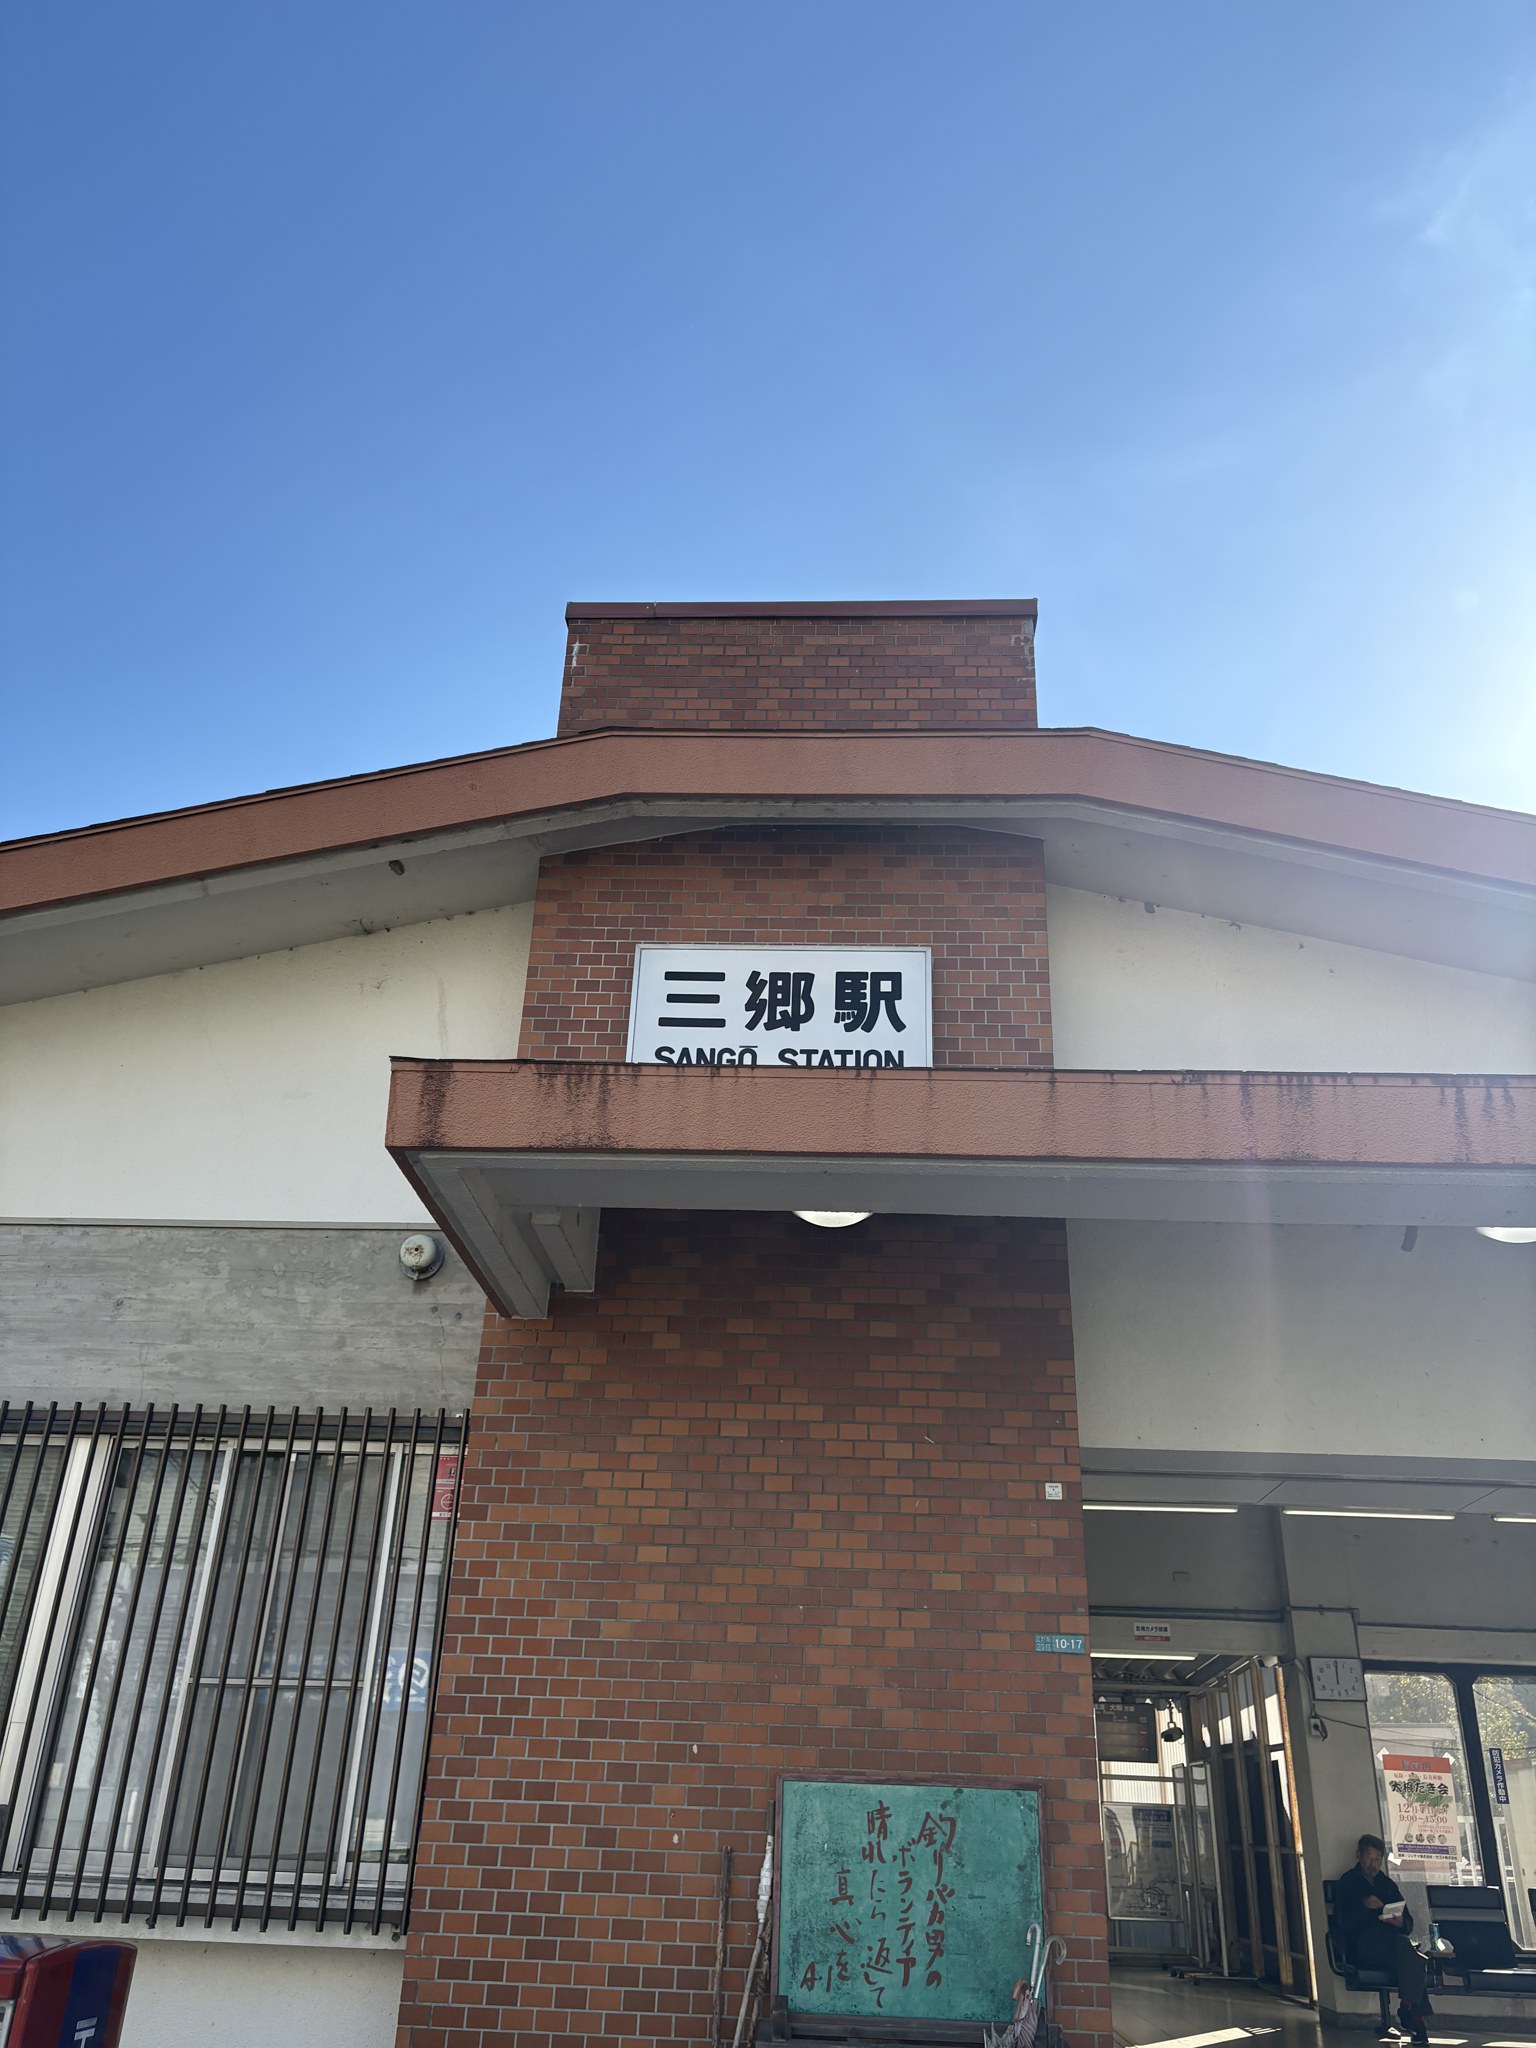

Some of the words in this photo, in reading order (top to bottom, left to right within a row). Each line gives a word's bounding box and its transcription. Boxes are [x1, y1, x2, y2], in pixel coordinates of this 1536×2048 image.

[657, 970, 907, 1033] 三郷駅
[778, 1048, 904, 1068] STATION
[1055, 1638, 1082, 1649] 10-17
[1491, 1749, 1506, 1802] 防犯カメラ作動中
[828, 1866, 861, 1982] 真心を
[892, 1837, 919, 1989] ボランティア
